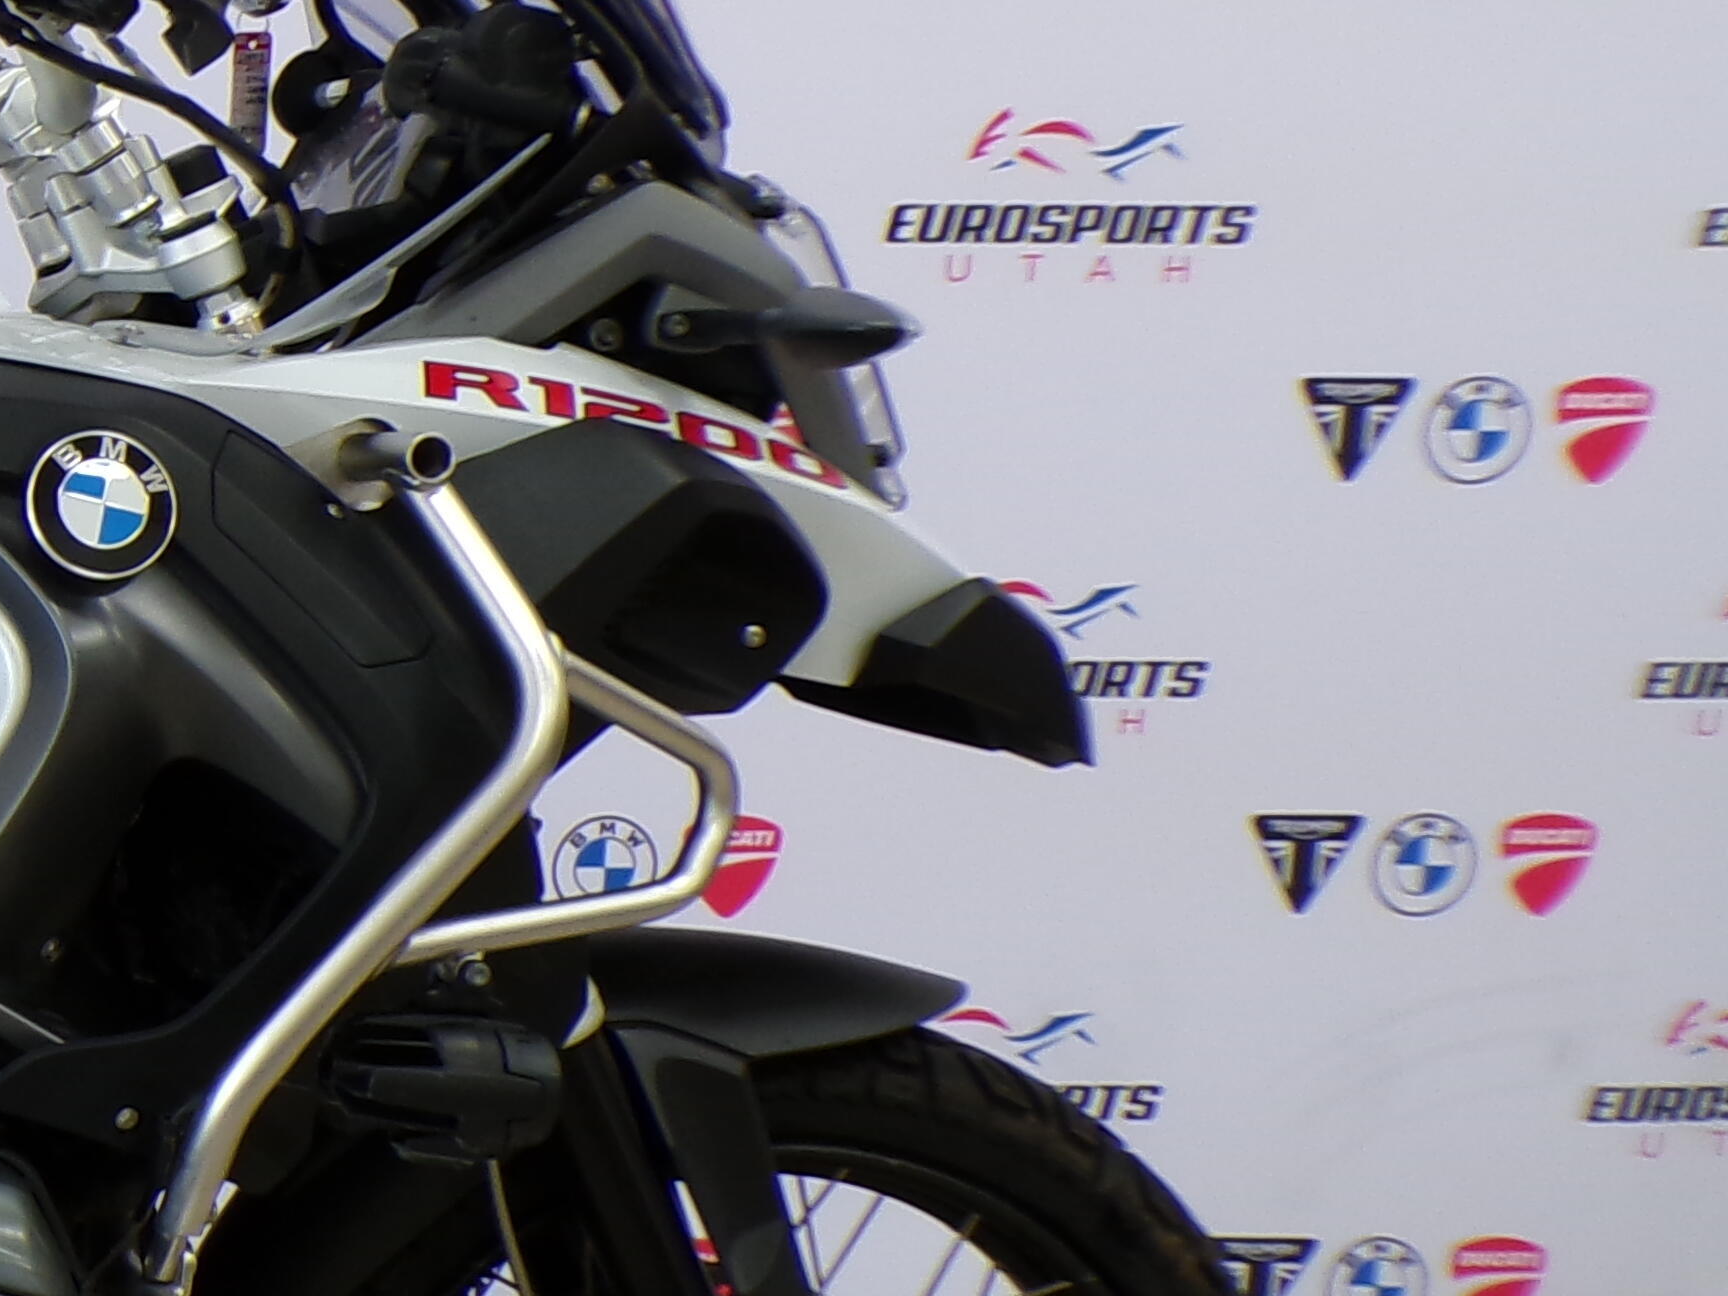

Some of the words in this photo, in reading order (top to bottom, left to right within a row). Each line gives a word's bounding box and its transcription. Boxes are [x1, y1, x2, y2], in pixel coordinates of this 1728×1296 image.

[885, 204, 1255, 245] EUROSPORTS
[944, 253, 1194, 285] UTAH
[52, 436, 169, 494] BMW
[568, 823, 645, 849] BMW
